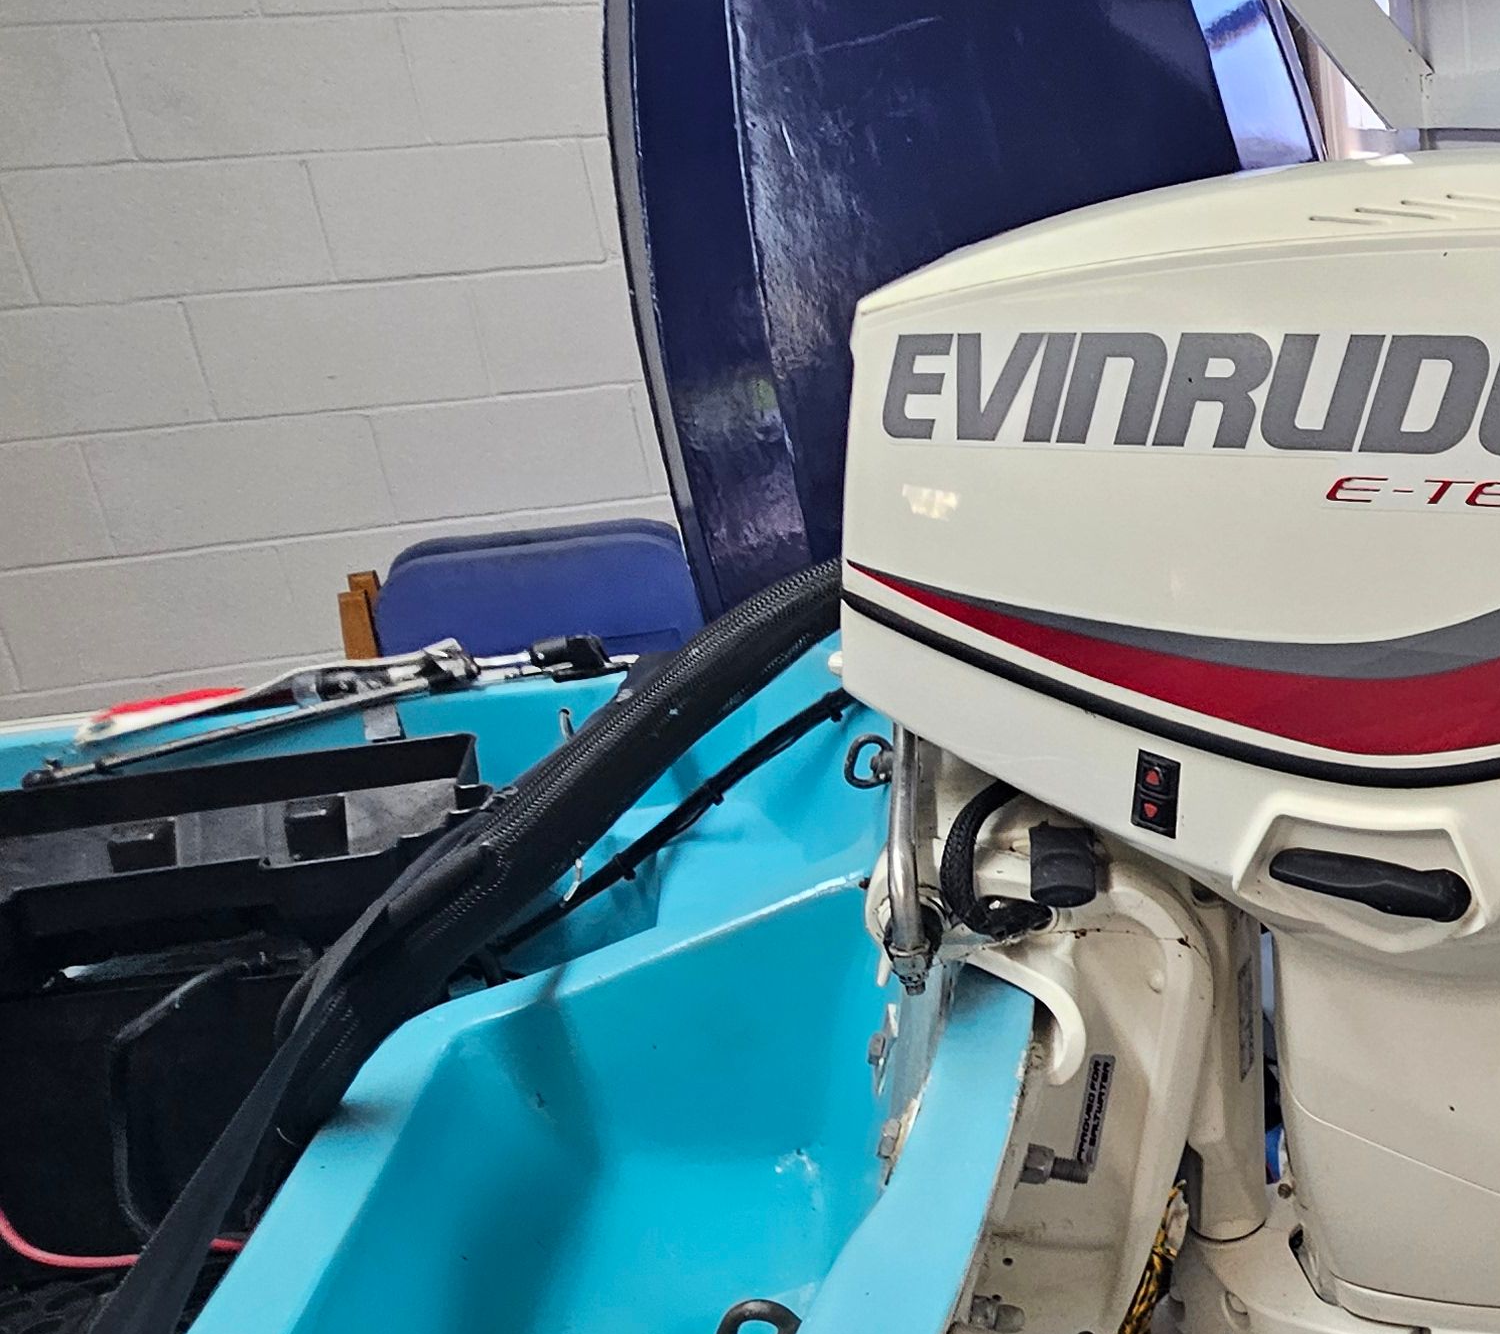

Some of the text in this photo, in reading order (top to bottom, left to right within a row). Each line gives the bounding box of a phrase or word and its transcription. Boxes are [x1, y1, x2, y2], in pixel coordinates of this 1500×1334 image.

[1076, 1059, 1101, 1165] PPROVED FOR
[1088, 1061, 1111, 1147] SALTWATER
